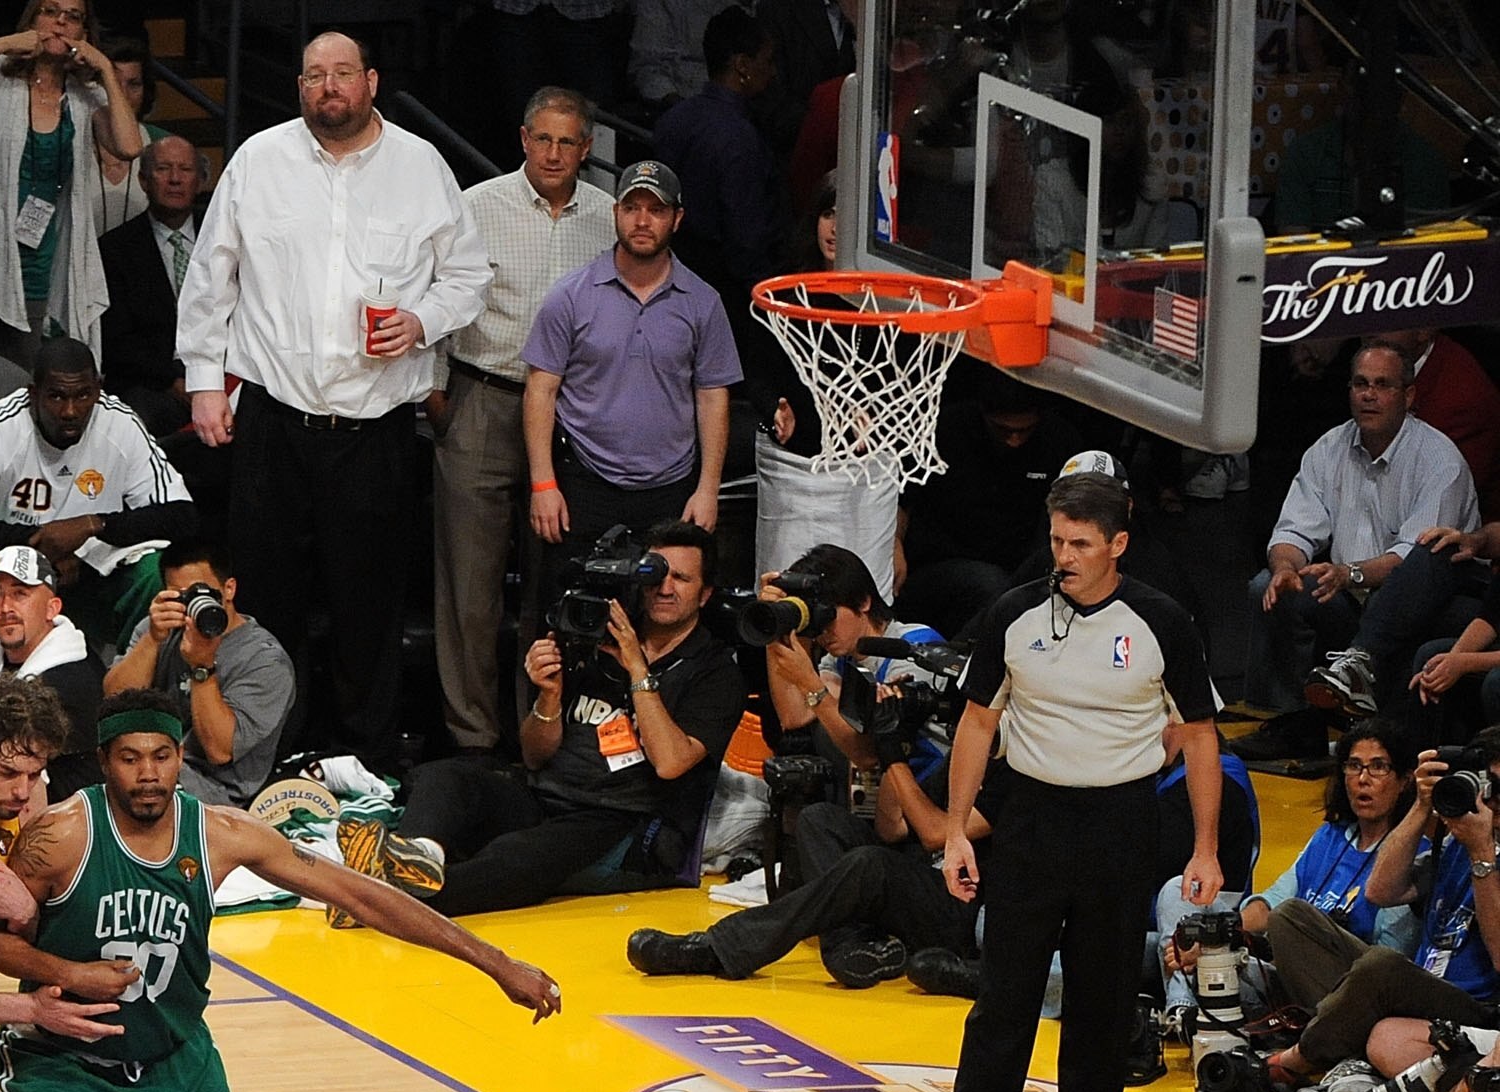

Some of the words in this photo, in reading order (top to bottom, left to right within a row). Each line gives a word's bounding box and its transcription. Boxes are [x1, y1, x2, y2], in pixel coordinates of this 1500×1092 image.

[1257, 27, 1291, 74] 4
[1261, 251, 1475, 344] Finals
[1262, 280, 1320, 326] The
[10, 476, 52, 512] 40
[573, 694, 629, 726] NB
[256, 789, 337, 818] PROSTRETCH
[94, 887, 191, 946] CELTICS
[674, 1022, 831, 1081] FIFTY
